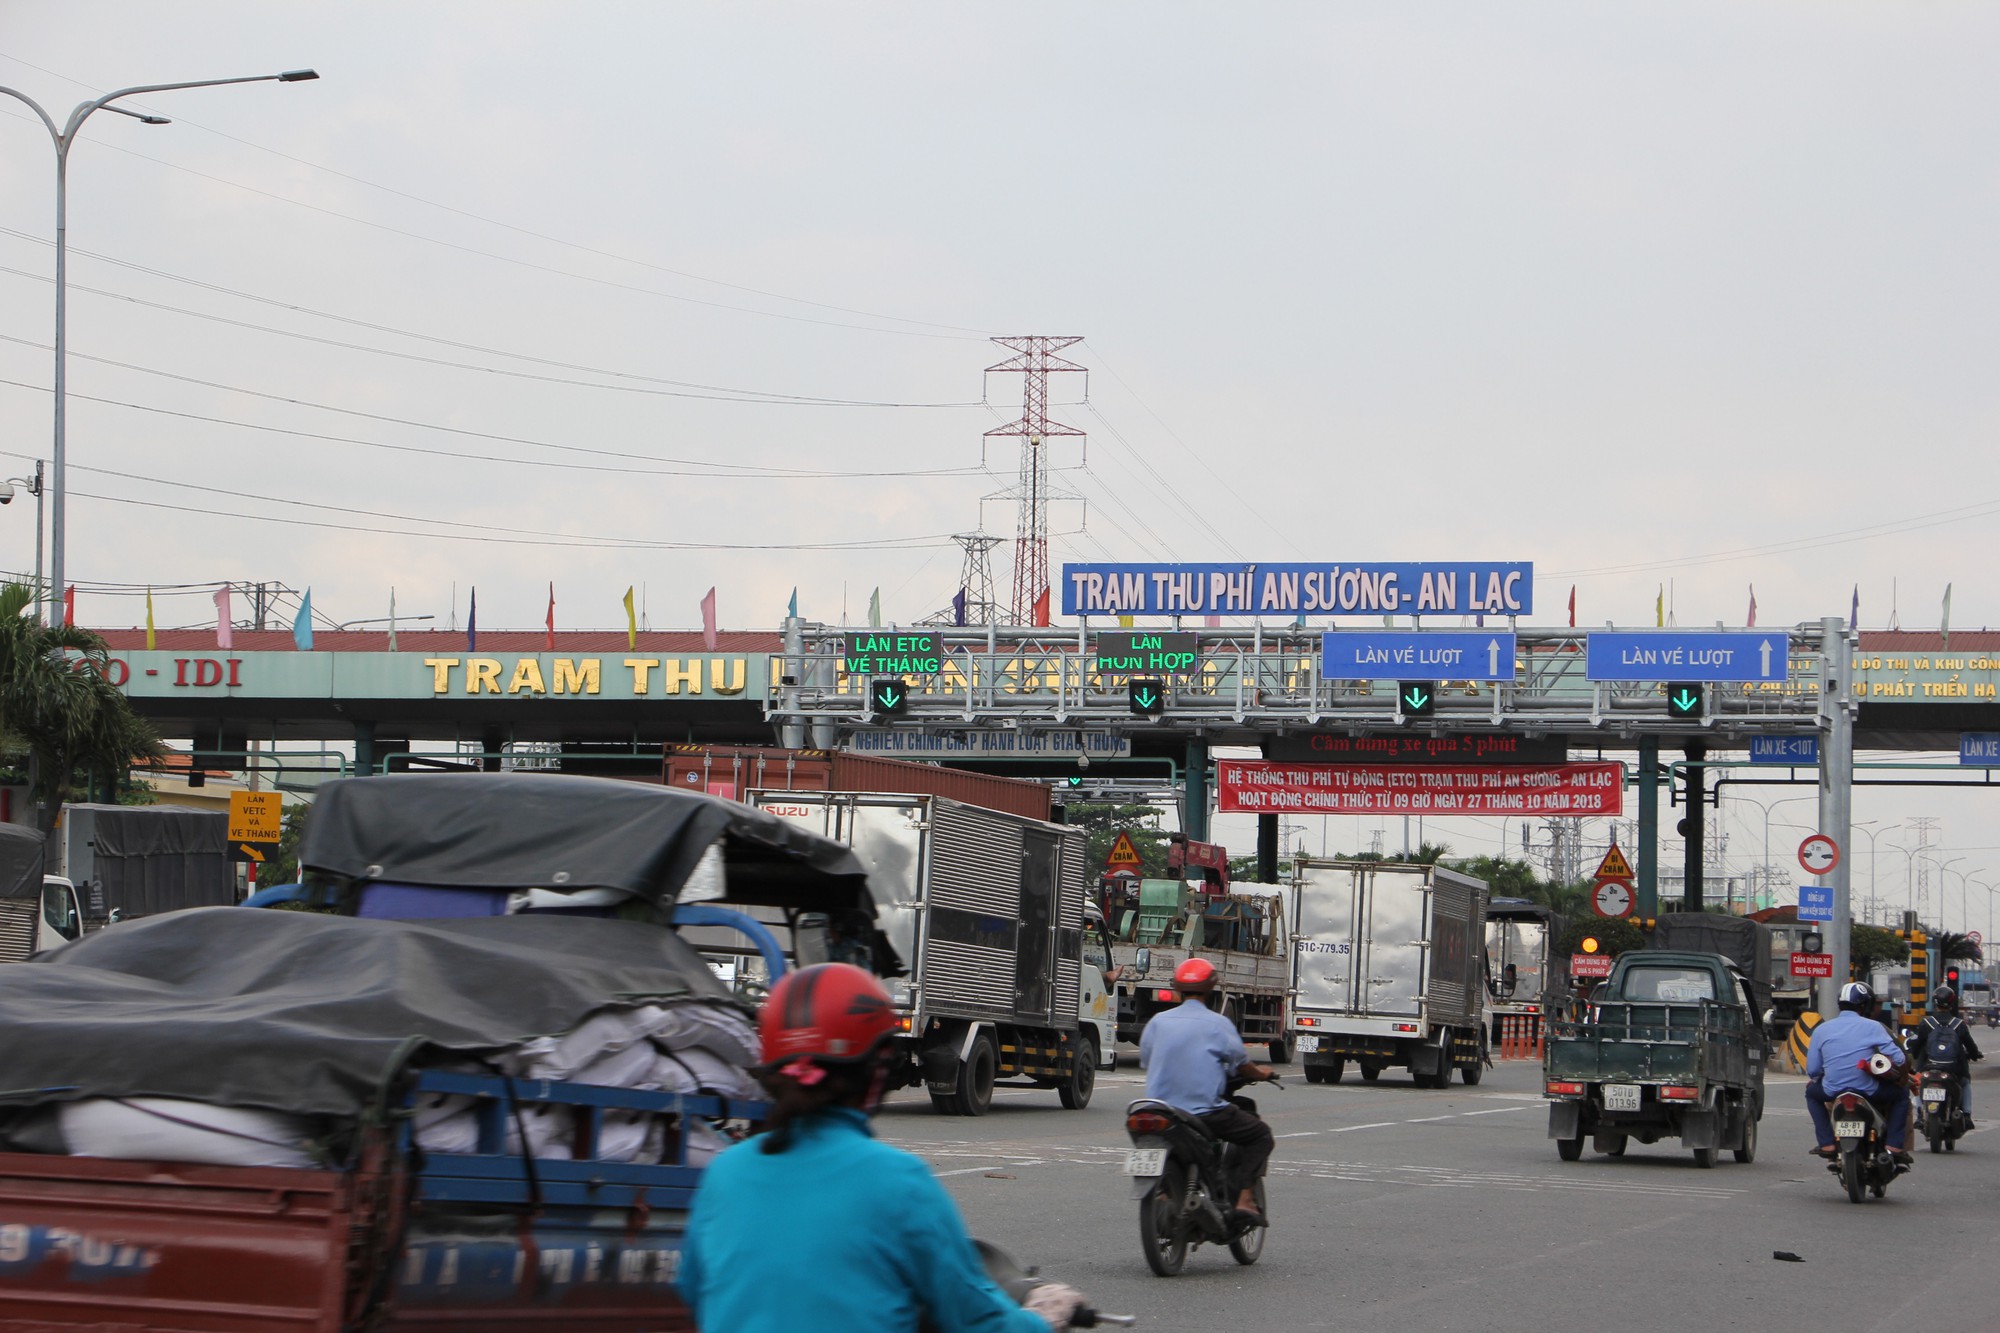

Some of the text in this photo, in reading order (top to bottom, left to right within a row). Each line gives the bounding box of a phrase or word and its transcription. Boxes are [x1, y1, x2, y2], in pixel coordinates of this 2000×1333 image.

[1071, 572, 1145, 615] TRẠM
[1152, 572, 1205, 611] THU
[1210, 565, 1256, 611] PHÍ
[1260, 572, 1299, 610] AN
[1303, 566, 1399, 611] SƯƠNG
[1417, 572, 1456, 610] AN
[1469, 571, 1521, 614] LẠC
[855, 634, 931, 652] LÀN ETC
[1131, 633, 1162, 649] LÀN
[848, 654, 939, 672] VÉ THÁNG
[1149, 652, 1195, 673] HỢP
[1355, 646, 1463, 667] LÀN VÉ LƯỢT
[1622, 646, 1734, 668] LÀN VÉ LƯỢT
[1886, 658, 1909, 675] THỊ
[1914, 656, 1930, 670] VÀ
[1935, 659, 1965, 670] KHU
[174, 659, 243, 686] IDI
[624, 659, 747, 695] THU
[1873, 679, 1915, 697] PHÁT
[1922, 674, 1968, 697] TRIỂN
[1974, 683, 1996, 702] HẠ
[1403, 739, 1421, 751] xe
[1463, 735, 1473, 751] 5
[1755, 737, 1773, 755] LÀN
[1776, 740, 1787, 754] XE
[1964, 738, 1998, 757] LÀN XE
[1228, 767, 1242, 786] HỆ
[1246, 766, 1284, 786] THỐNG
[1287, 771, 1309, 786] THU
[1313, 769, 1331, 786] PHÍ
[1334, 770, 1350, 789] TỰ
[1353, 769, 1384, 790] ĐỘNG
[1388, 772, 1416, 788] (ETC)
[1420, 773, 1453, 789] TRẠM
[1456, 773, 1478, 787] THU
[1482, 771, 1501, 787] PHÍ
[1505, 773, 1520, 787] AN
[1523, 771, 1561, 787] SƯƠNG
[1571, 772, 1587, 786] AN
[1590, 772, 1612, 789] LẠC
[1238, 789, 1602, 809] HOẠT ĐỘNG CHÍNH THỨC TỪ 09 GIỜ NGÀY 27 THÁNG 10 NĂM 2018
[243, 807, 266, 815] VETC
[762, 805, 809, 817] ISUZU
[1298, 941, 1350, 955] 51C-779.35
[1823, 957, 1831, 965] XE
